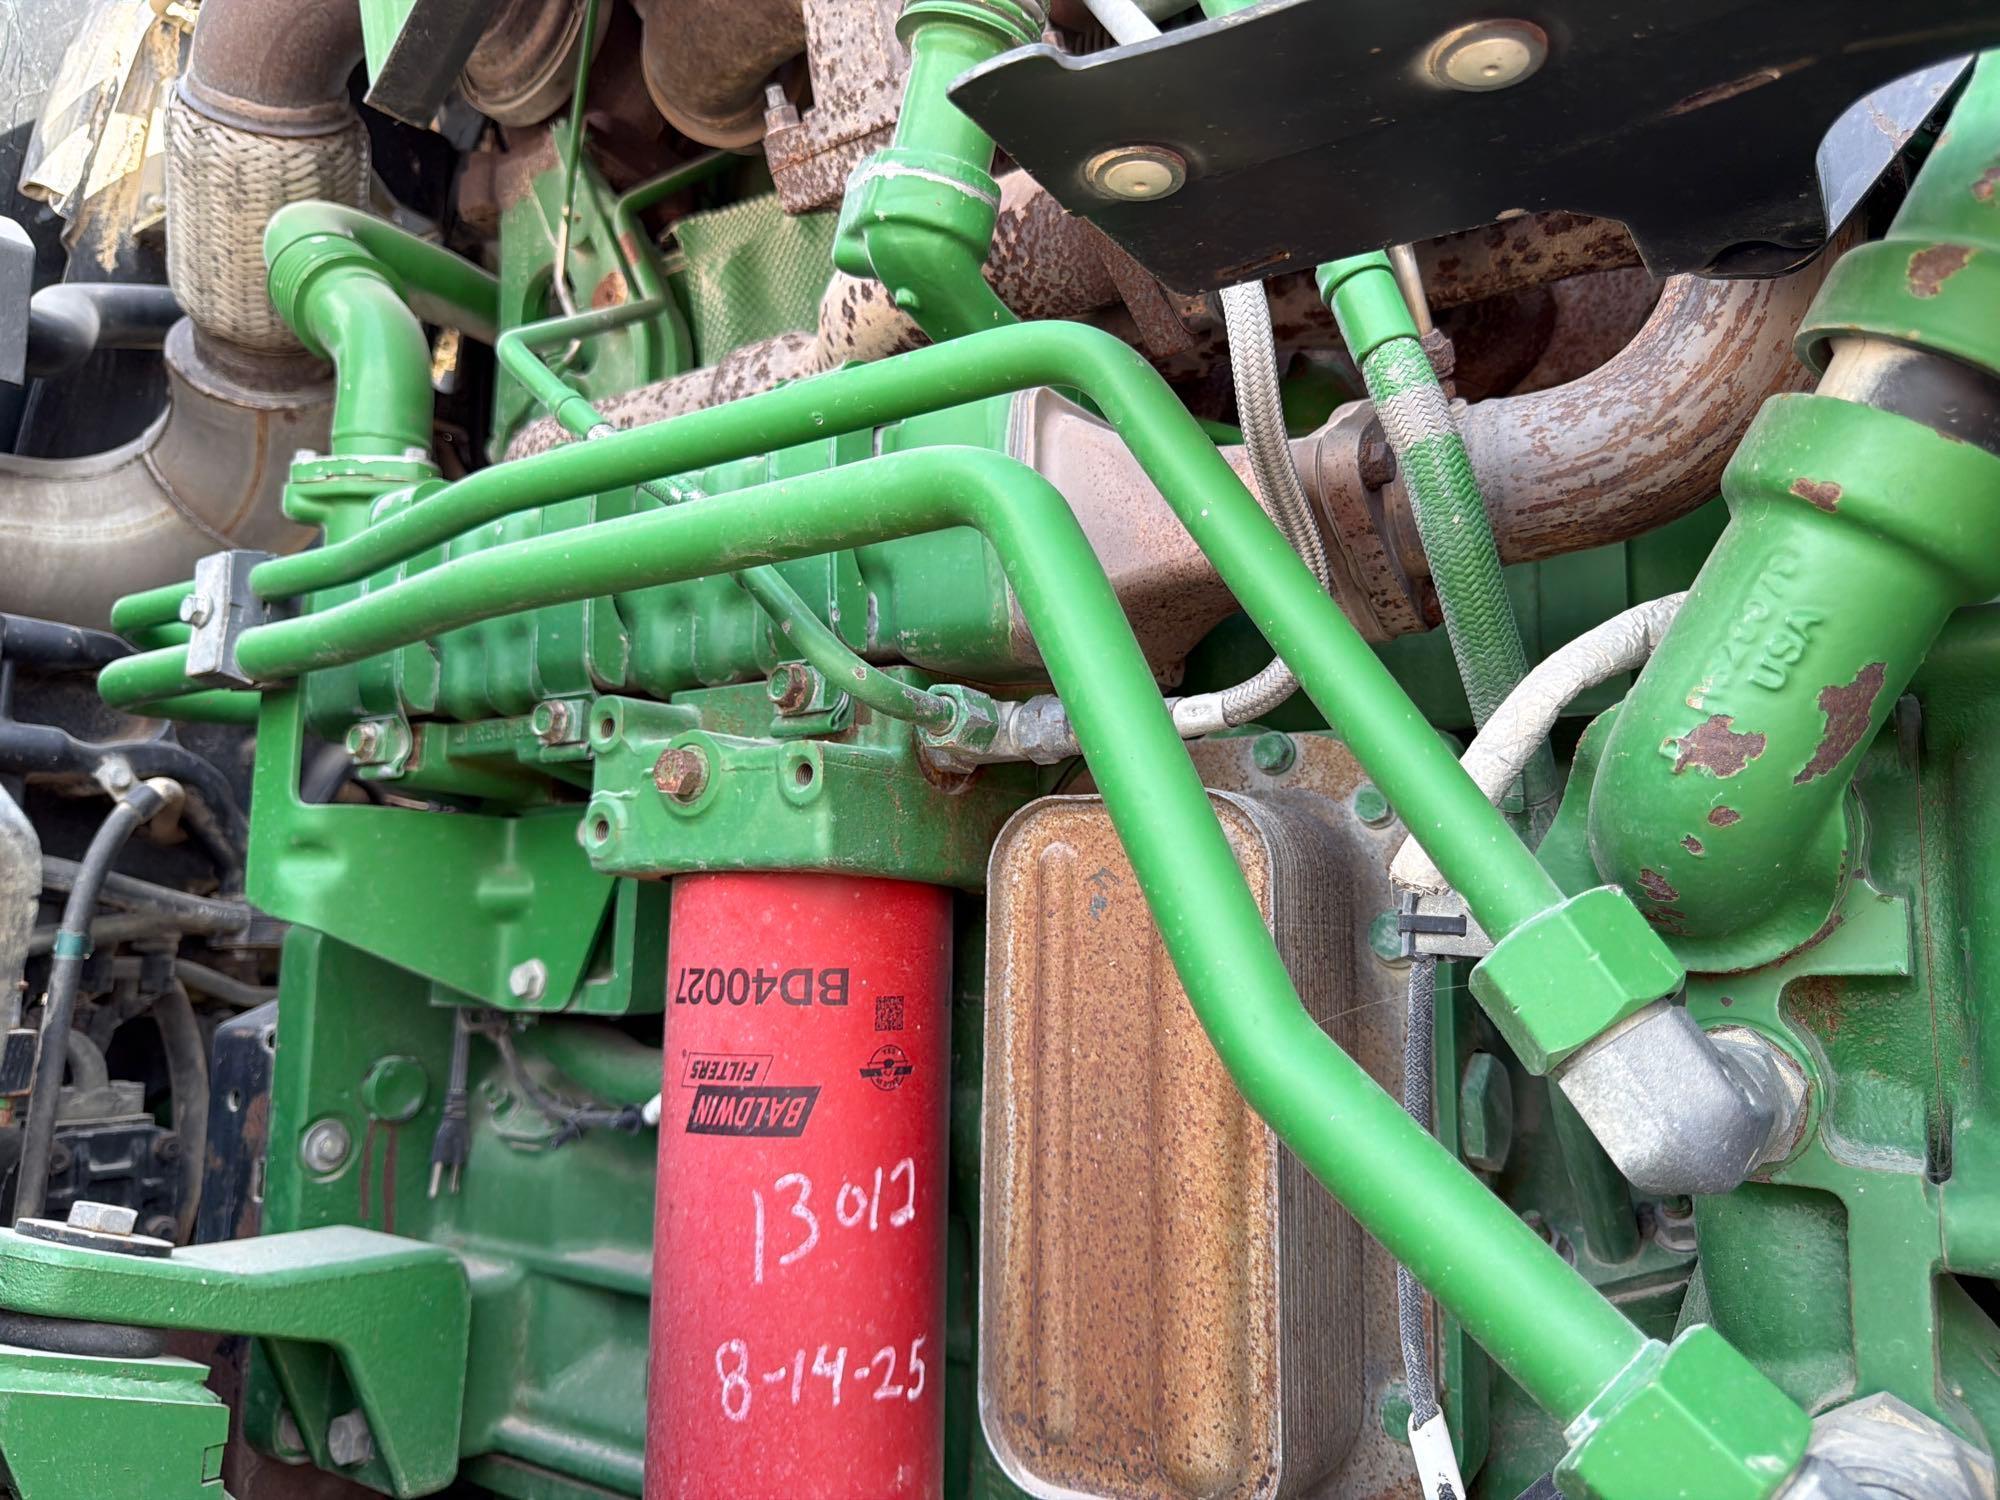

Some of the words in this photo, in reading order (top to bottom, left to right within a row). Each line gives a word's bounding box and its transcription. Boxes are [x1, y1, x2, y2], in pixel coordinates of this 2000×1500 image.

[1747, 609, 1826, 692] USA
[676, 967, 850, 1006] BD40027
[690, 1059, 760, 1081] FILTERS
[692, 1094, 808, 1128] BALDWIN
[715, 1335, 927, 1422] 8-14-25
